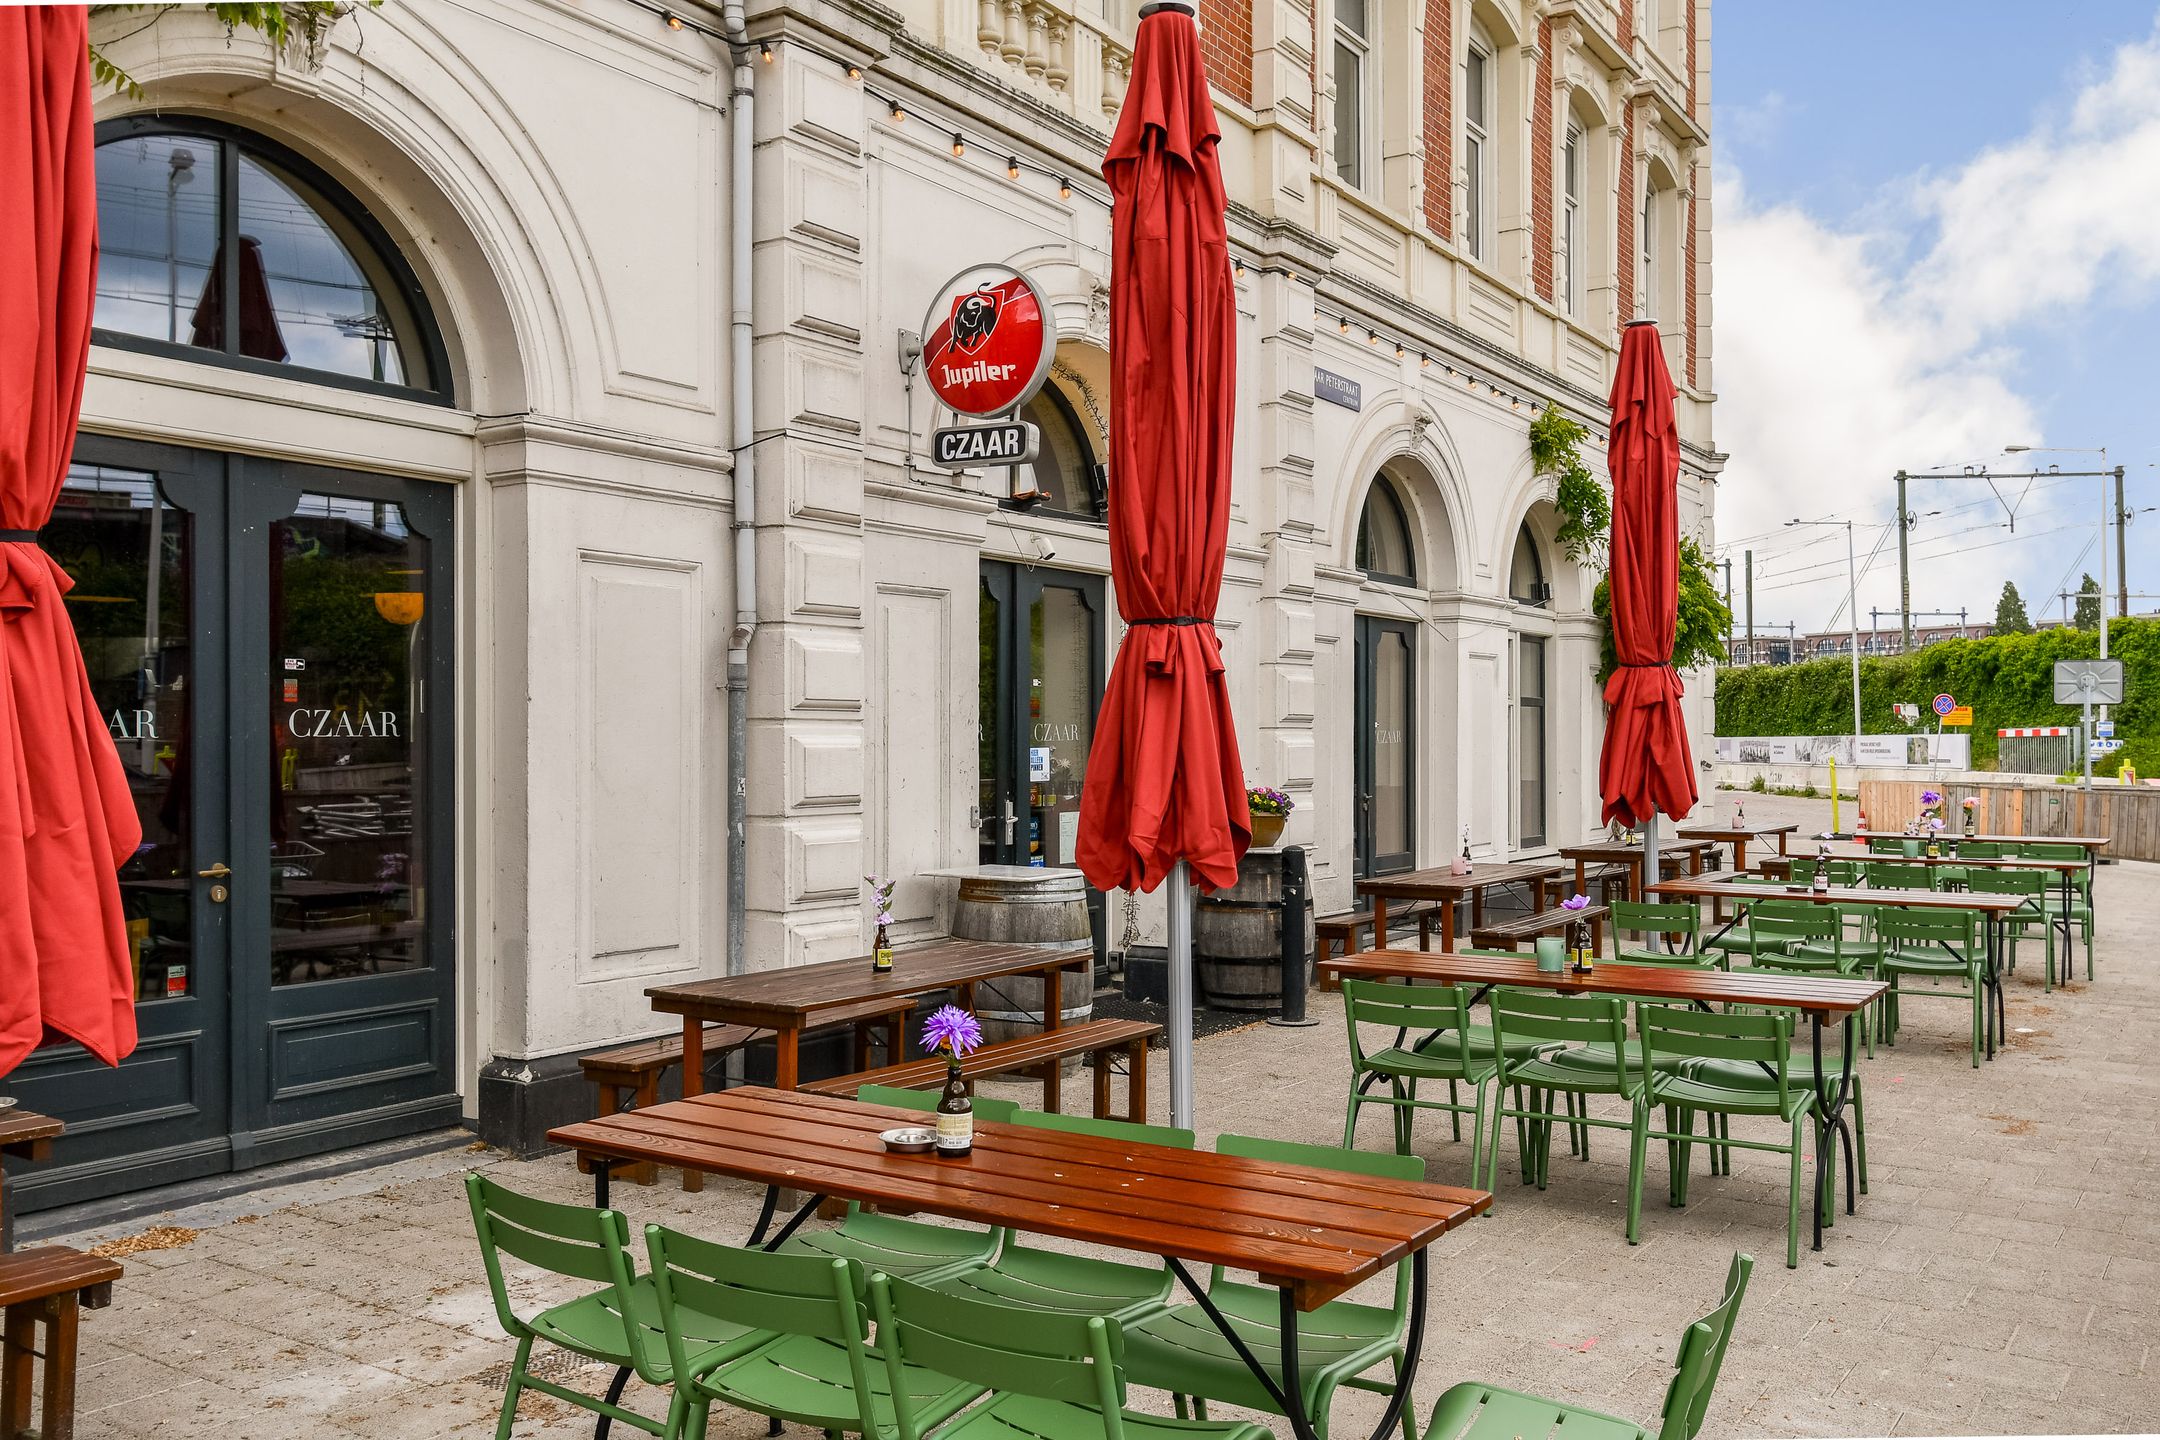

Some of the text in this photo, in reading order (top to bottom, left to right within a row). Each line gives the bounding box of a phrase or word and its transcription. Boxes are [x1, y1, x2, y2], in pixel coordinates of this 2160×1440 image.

[941, 360, 1016, 389] Jupiler
[942, 429, 1019, 460] CZAAR
[288, 708, 401, 738] CZAAR
[1034, 723, 1080, 742] CZAAR
[1376, 730, 1402, 743] CZAAR
